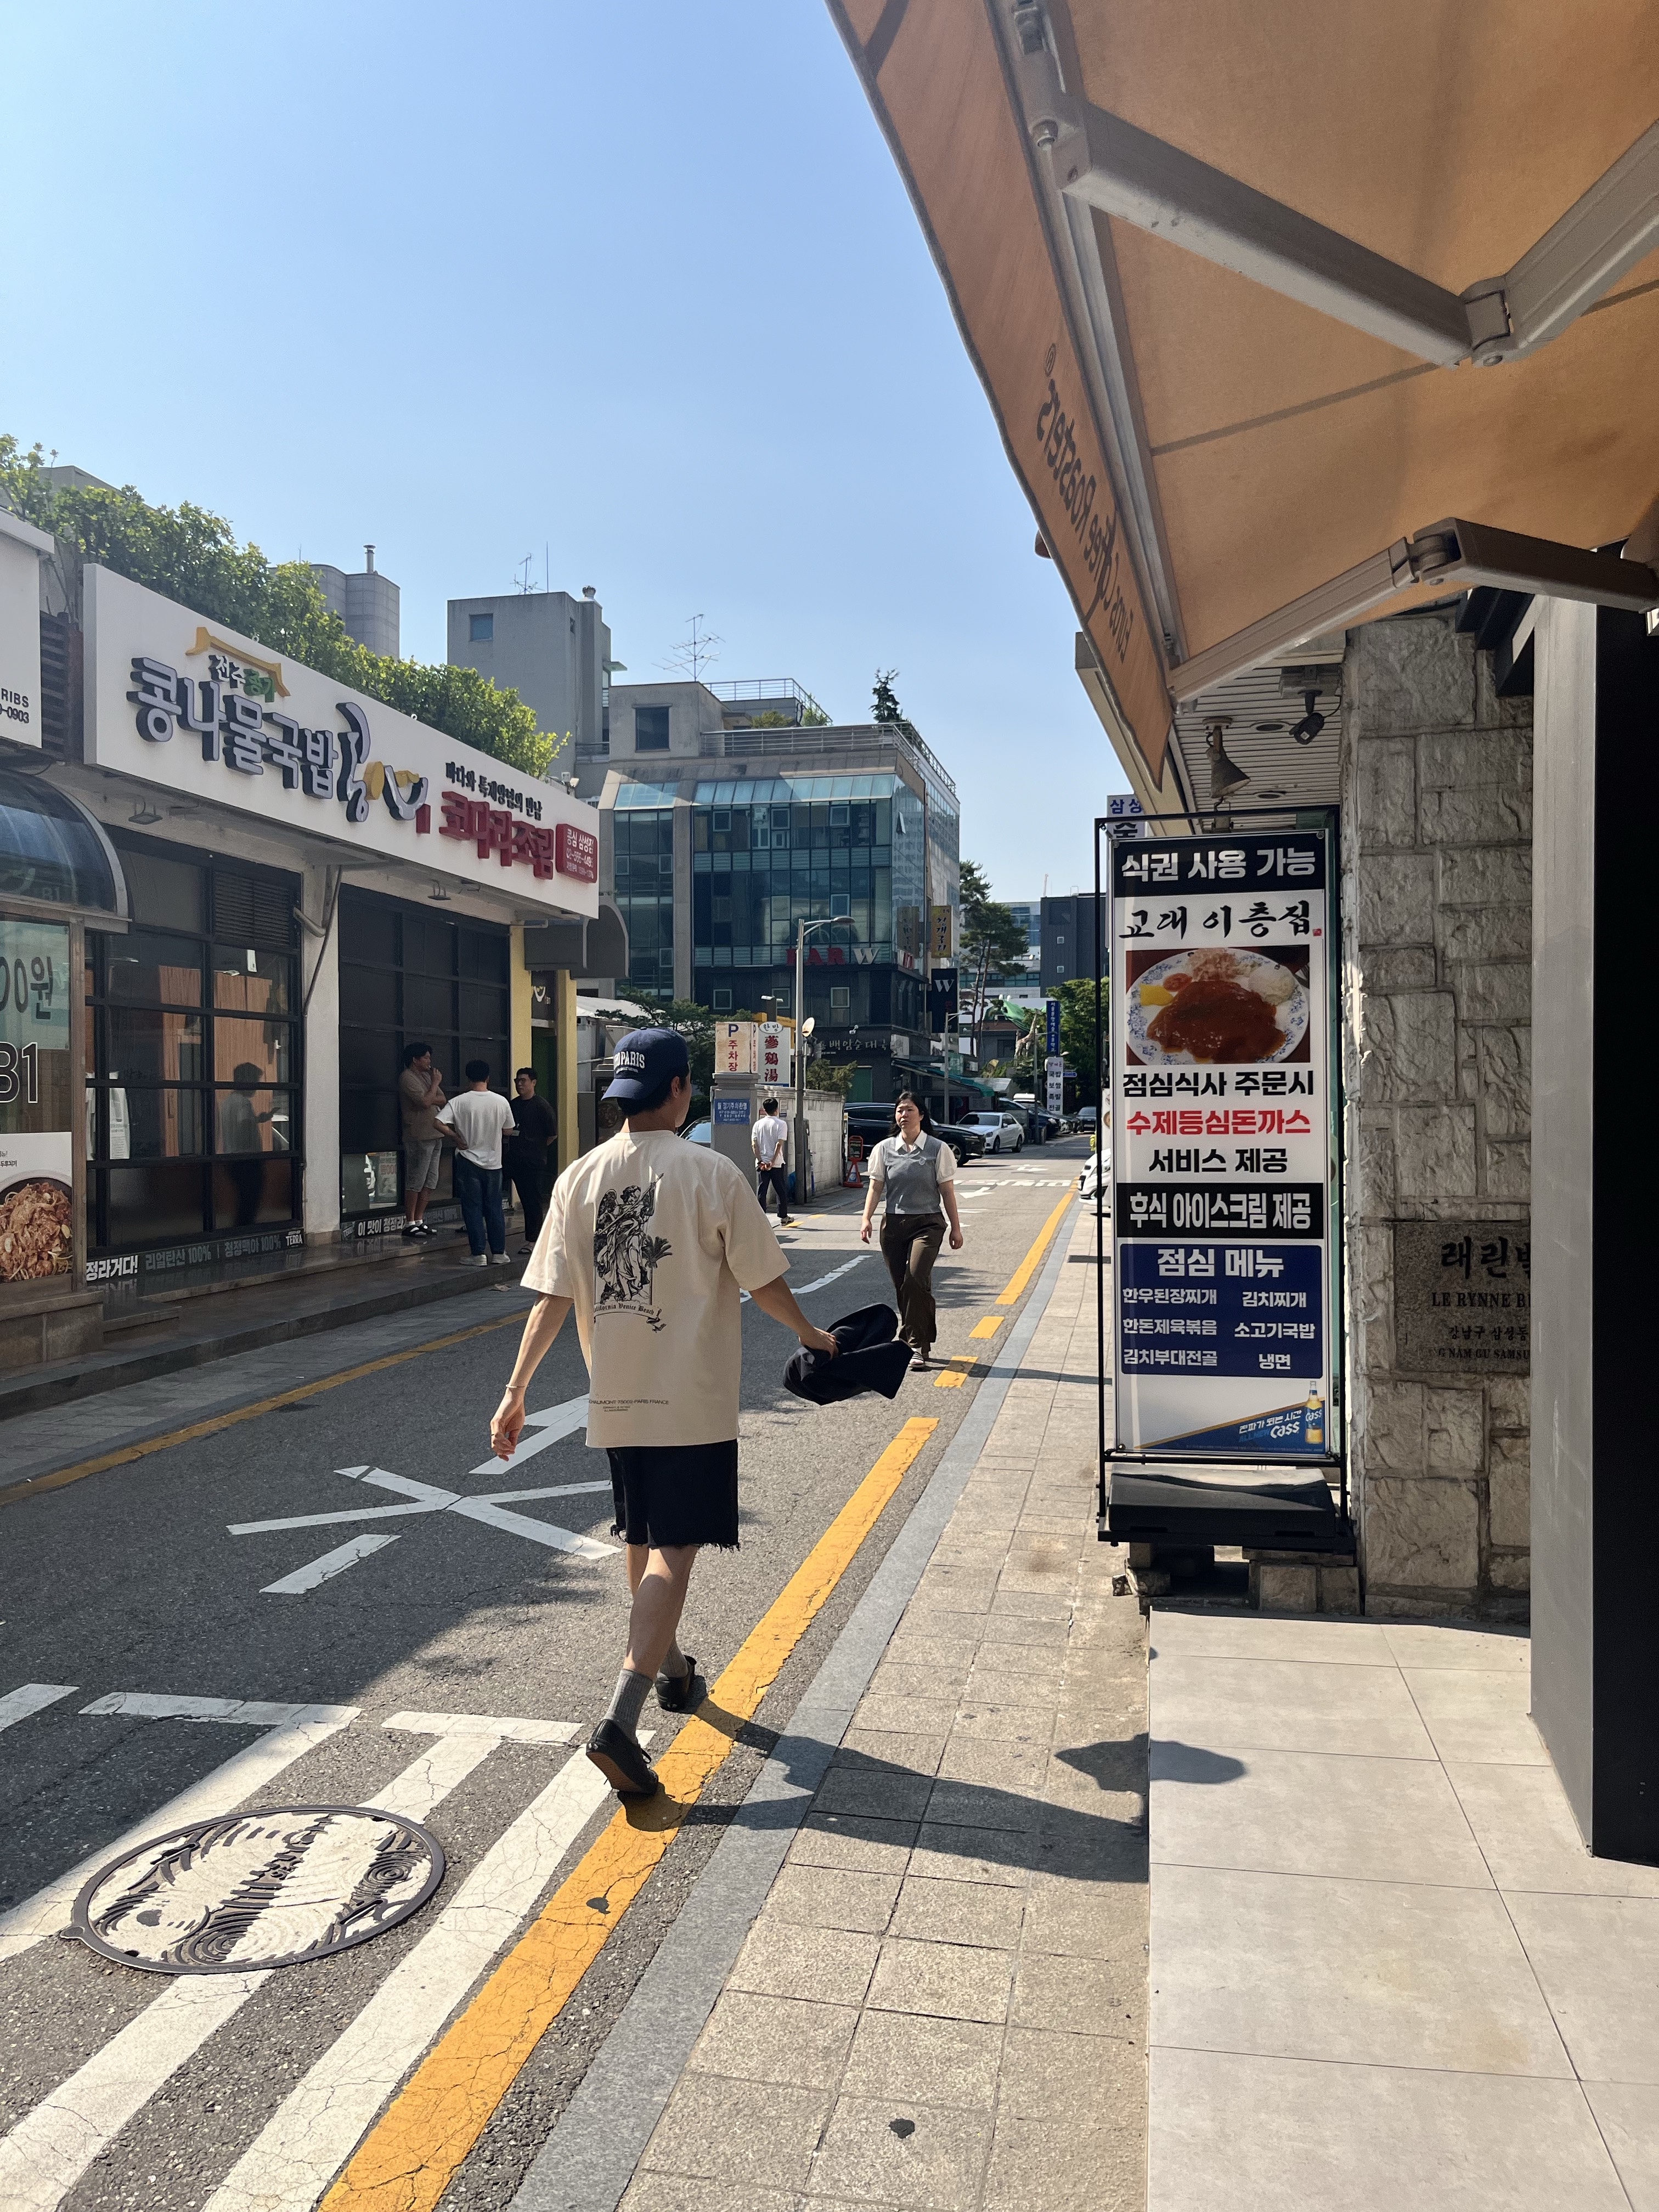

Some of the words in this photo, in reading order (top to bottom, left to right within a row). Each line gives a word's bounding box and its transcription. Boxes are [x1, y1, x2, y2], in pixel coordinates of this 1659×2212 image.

[1, 688, 29, 708] RIBS
[0, 703, 29, 724] -0903
[126, 657, 338, 800] 콩나물국밥
[526, 797, 543, 821] 만남
[439, 791, 554, 880] 코다리조림
[579, 834, 594, 854] 삼성점
[1122, 854, 1178, 882] 식권
[1188, 850, 1246, 879] 사용
[1257, 848, 1315, 876] 가능
[1119, 906, 1187, 940] 교대
[1203, 900, 1310, 938] 이층집
[853, 948, 880, 965] W
[934, 979, 955, 992] W
[729, 1024, 739, 1037] P
[763, 1024, 780, 1032] 한방
[728, 1040, 738, 1071] 주차장
[1122, 1072, 1227, 1097] 점심식사
[1234, 1070, 1314, 1096] 주문시
[1126, 1109, 1311, 1135] 수제등심돈까스
[1149, 1148, 1227, 1173] 서비스
[1235, 1148, 1288, 1173] 제공
[1130, 1192, 1167, 1228] 후식
[1173, 1193, 1267, 1229] 아이스크림
[1272, 1193, 1311, 1229] 제공
[358, 1222, 365, 1236] 이
[367, 1218, 382, 1235] 맛이
[188, 1245, 211, 1263] 100%
[261, 1235, 281, 1252] 100%
[285, 1234, 303, 1246] TERRA
[1158, 1249, 1215, 1277] 점심
[1224, 1249, 1284, 1278] 메뉴
[1122, 1288, 1217, 1304] 한우된장찌개
[1242, 1291, 1307, 1307] 김치찌개
[1431, 1292, 1451, 1307] LE
[1123, 1318, 1217, 1335] 한돈제육볶음
[1234, 1322, 1316, 1339] 소고기국밥
[1449, 1325, 1486, 1340] 강남구
[1491, 1326, 1528, 1341] 삼성동
[1124, 1349, 1217, 1366] 김치부대전골
[1259, 1353, 1291, 1370] 냉면
[1266, 1415, 1284, 1426] 되는
[1284, 1409, 1302, 1422] 시간
